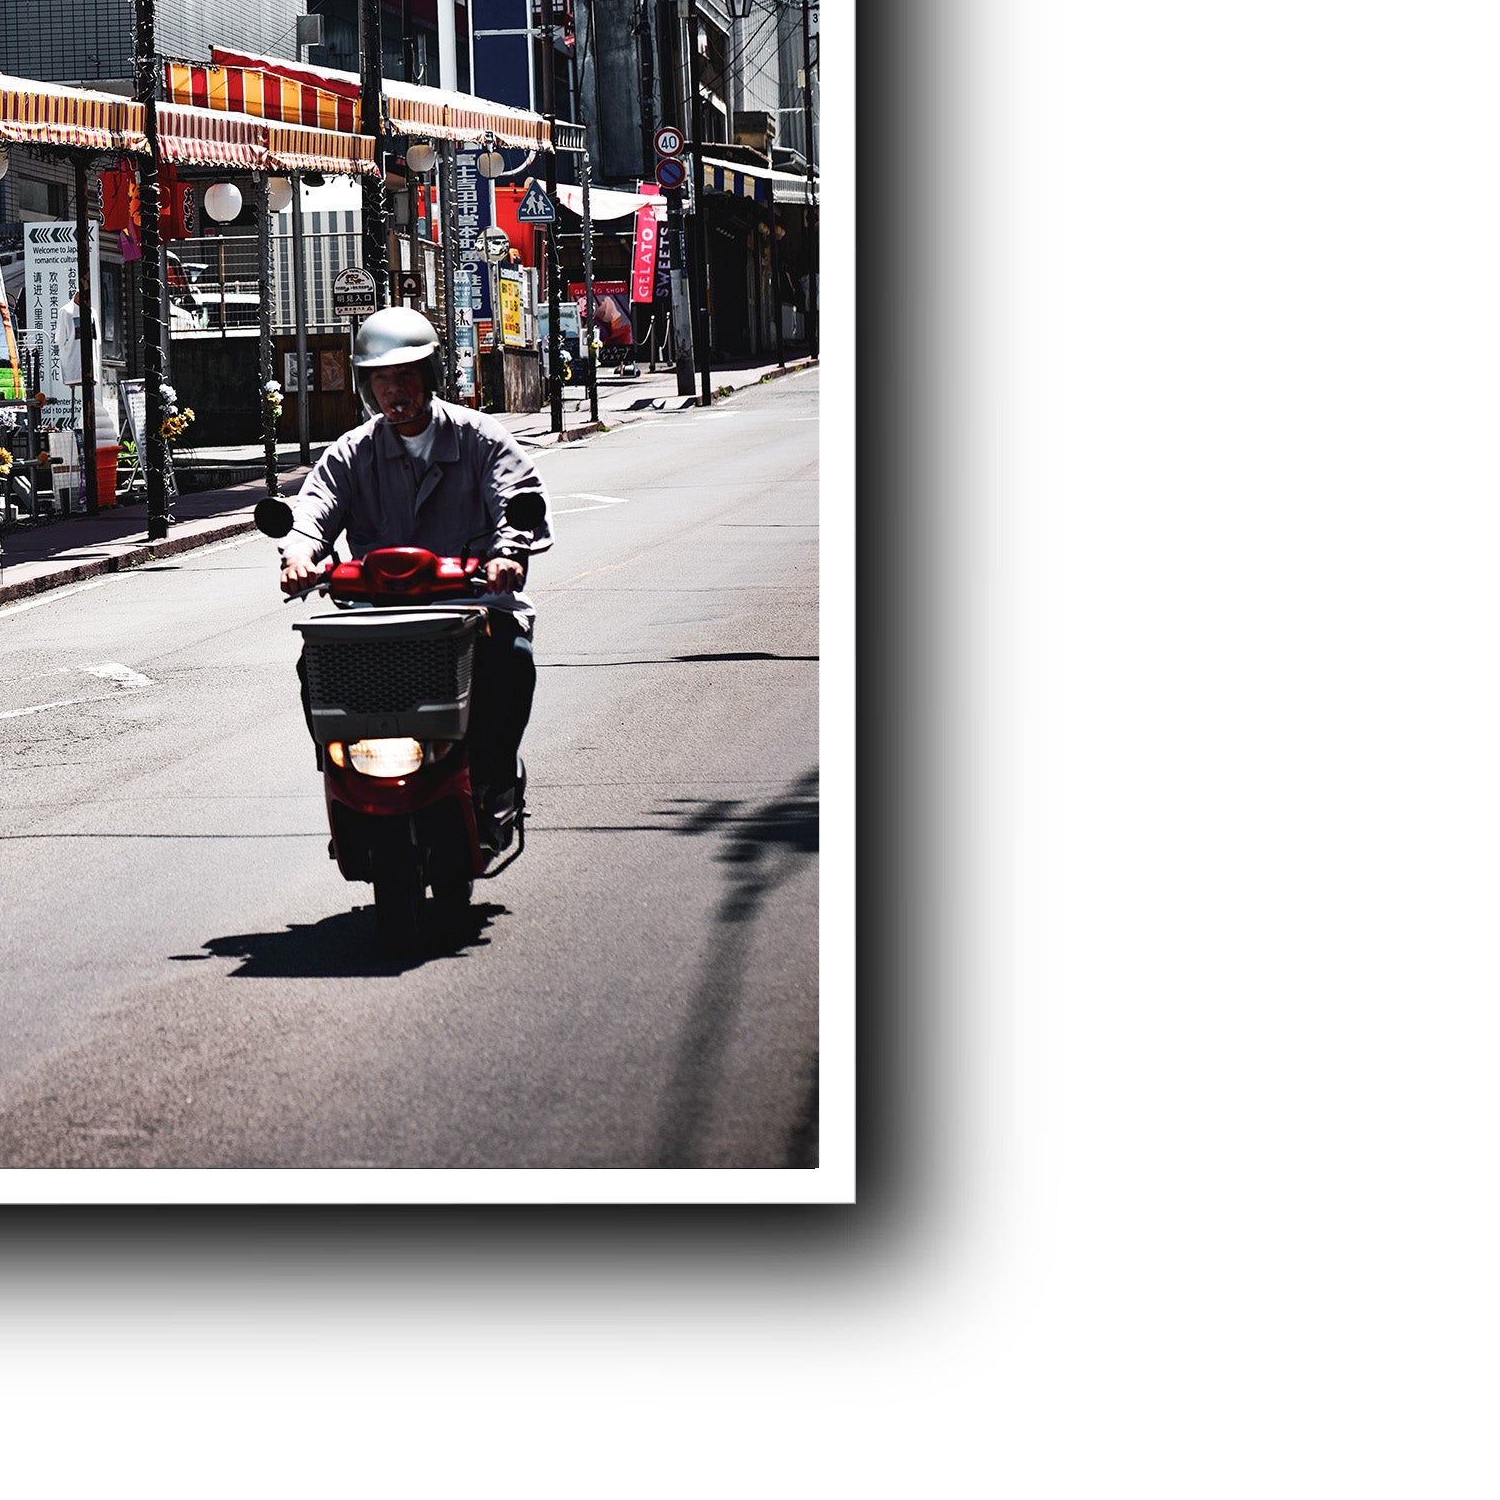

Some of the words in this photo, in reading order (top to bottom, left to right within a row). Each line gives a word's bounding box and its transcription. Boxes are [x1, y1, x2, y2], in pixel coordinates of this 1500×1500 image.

[661, 136, 677, 149] 40
[638, 227, 654, 297] GELATO
[656, 227, 671, 297] SWEETS
[574, 287, 602, 295] GELTO
[605, 286, 625, 294] SHOP
